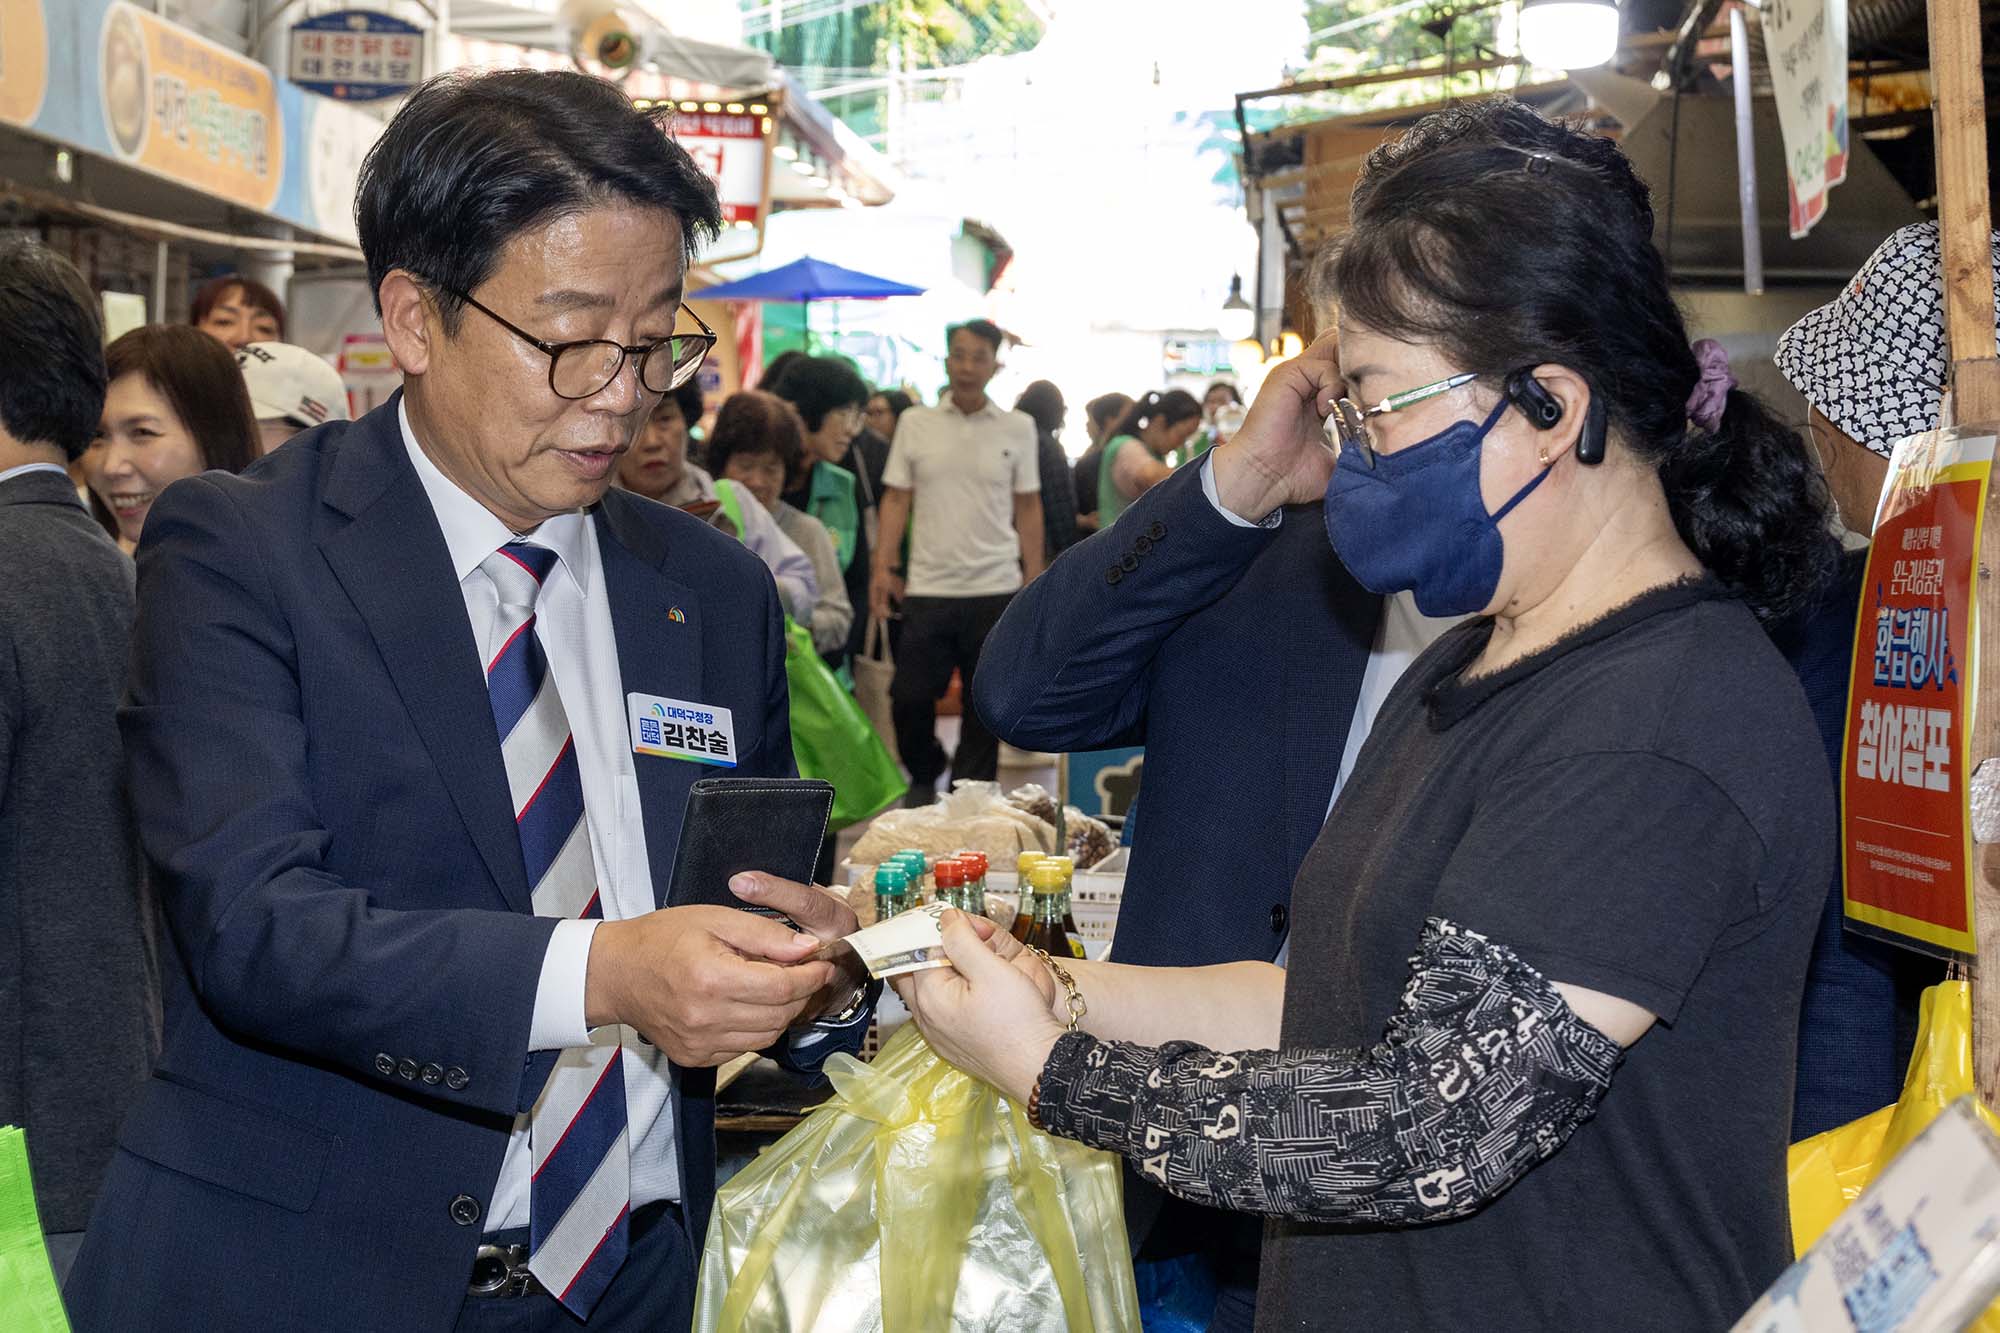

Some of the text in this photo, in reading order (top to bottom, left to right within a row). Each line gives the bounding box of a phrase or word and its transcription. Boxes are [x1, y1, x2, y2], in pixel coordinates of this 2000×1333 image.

[1890, 558, 1945, 596] 온누리상품권
[1874, 608, 1948, 689] 환급행사
[666, 705, 714, 725] 대덕구청장
[662, 721, 729, 756] 김찬술
[1857, 698, 1952, 793] 참여점포
